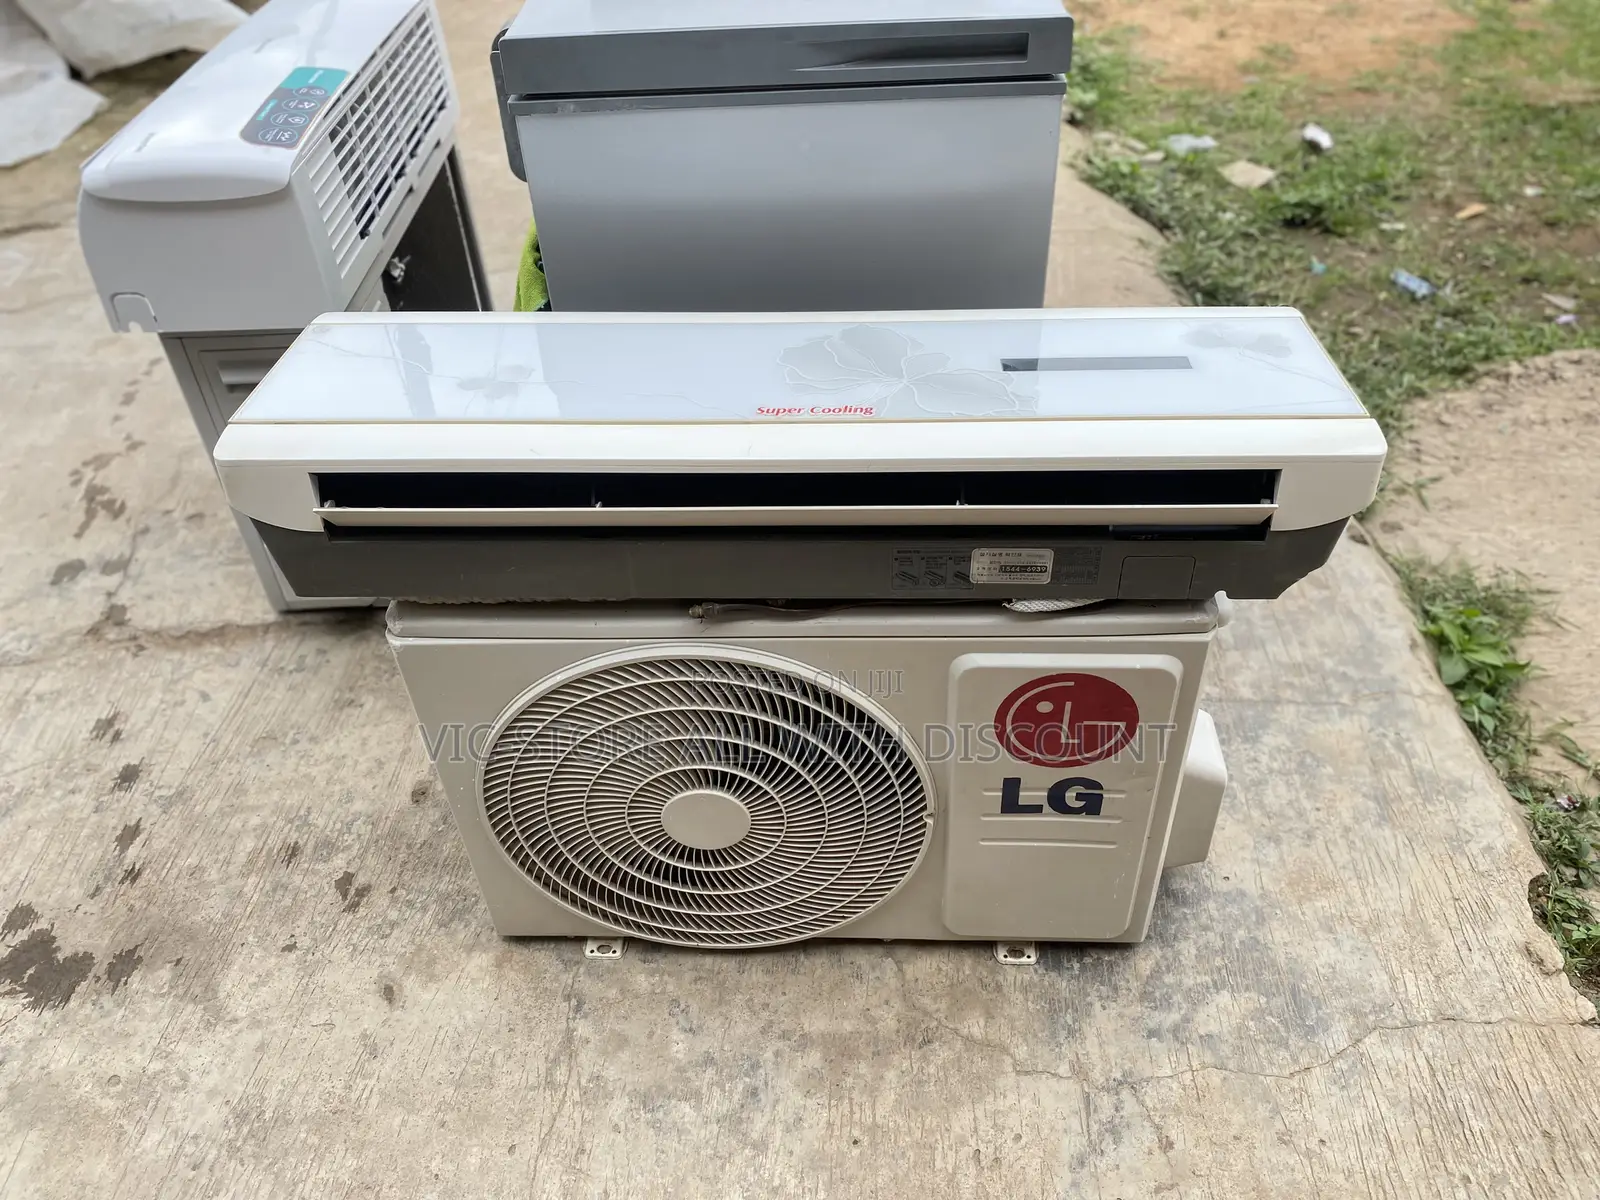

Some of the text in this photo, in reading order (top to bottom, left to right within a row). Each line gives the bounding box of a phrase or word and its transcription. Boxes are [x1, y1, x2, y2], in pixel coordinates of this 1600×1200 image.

[756, 405, 874, 417] Super Cooling
[1000, 777, 1104, 816] LG
